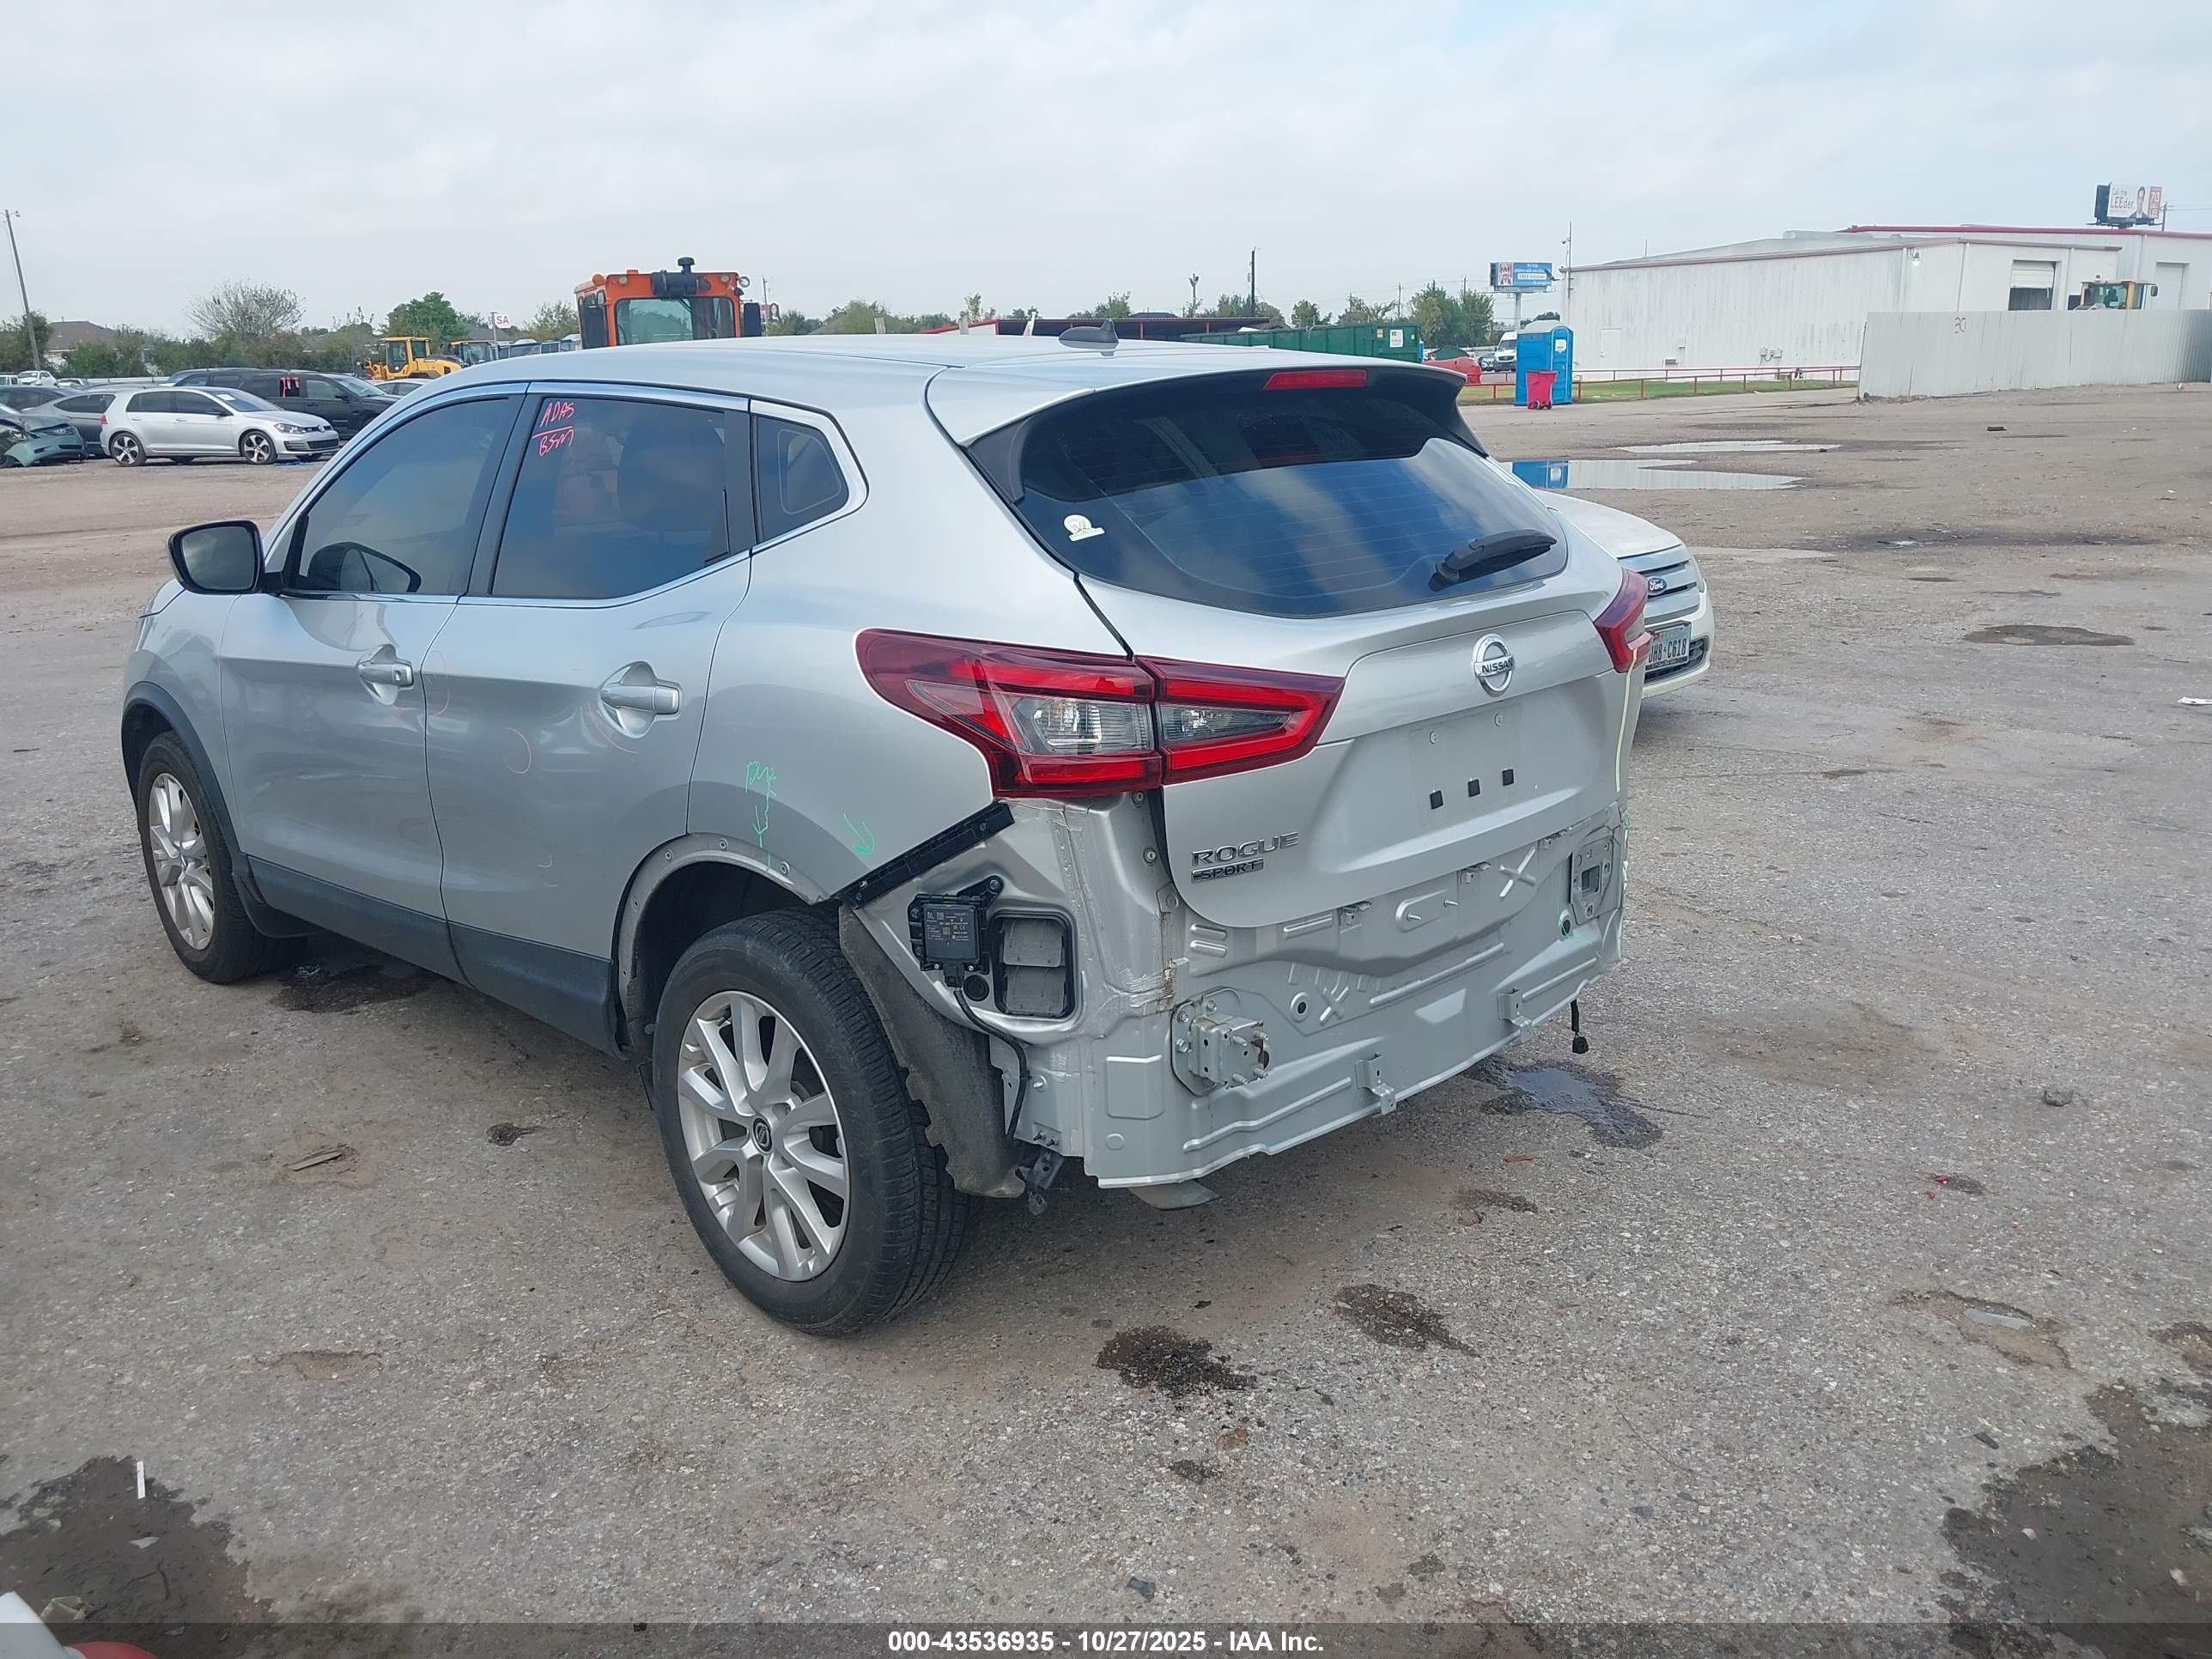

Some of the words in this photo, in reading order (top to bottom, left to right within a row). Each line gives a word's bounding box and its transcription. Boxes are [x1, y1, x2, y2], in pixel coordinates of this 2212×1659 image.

[539, 401, 574, 428] ADAS
[1649, 579, 1664, 591] Ford
[1481, 658, 1513, 674] NISSAN
[1191, 831, 1299, 867] ROGUE
[1200, 860, 1258, 880] SPORT
